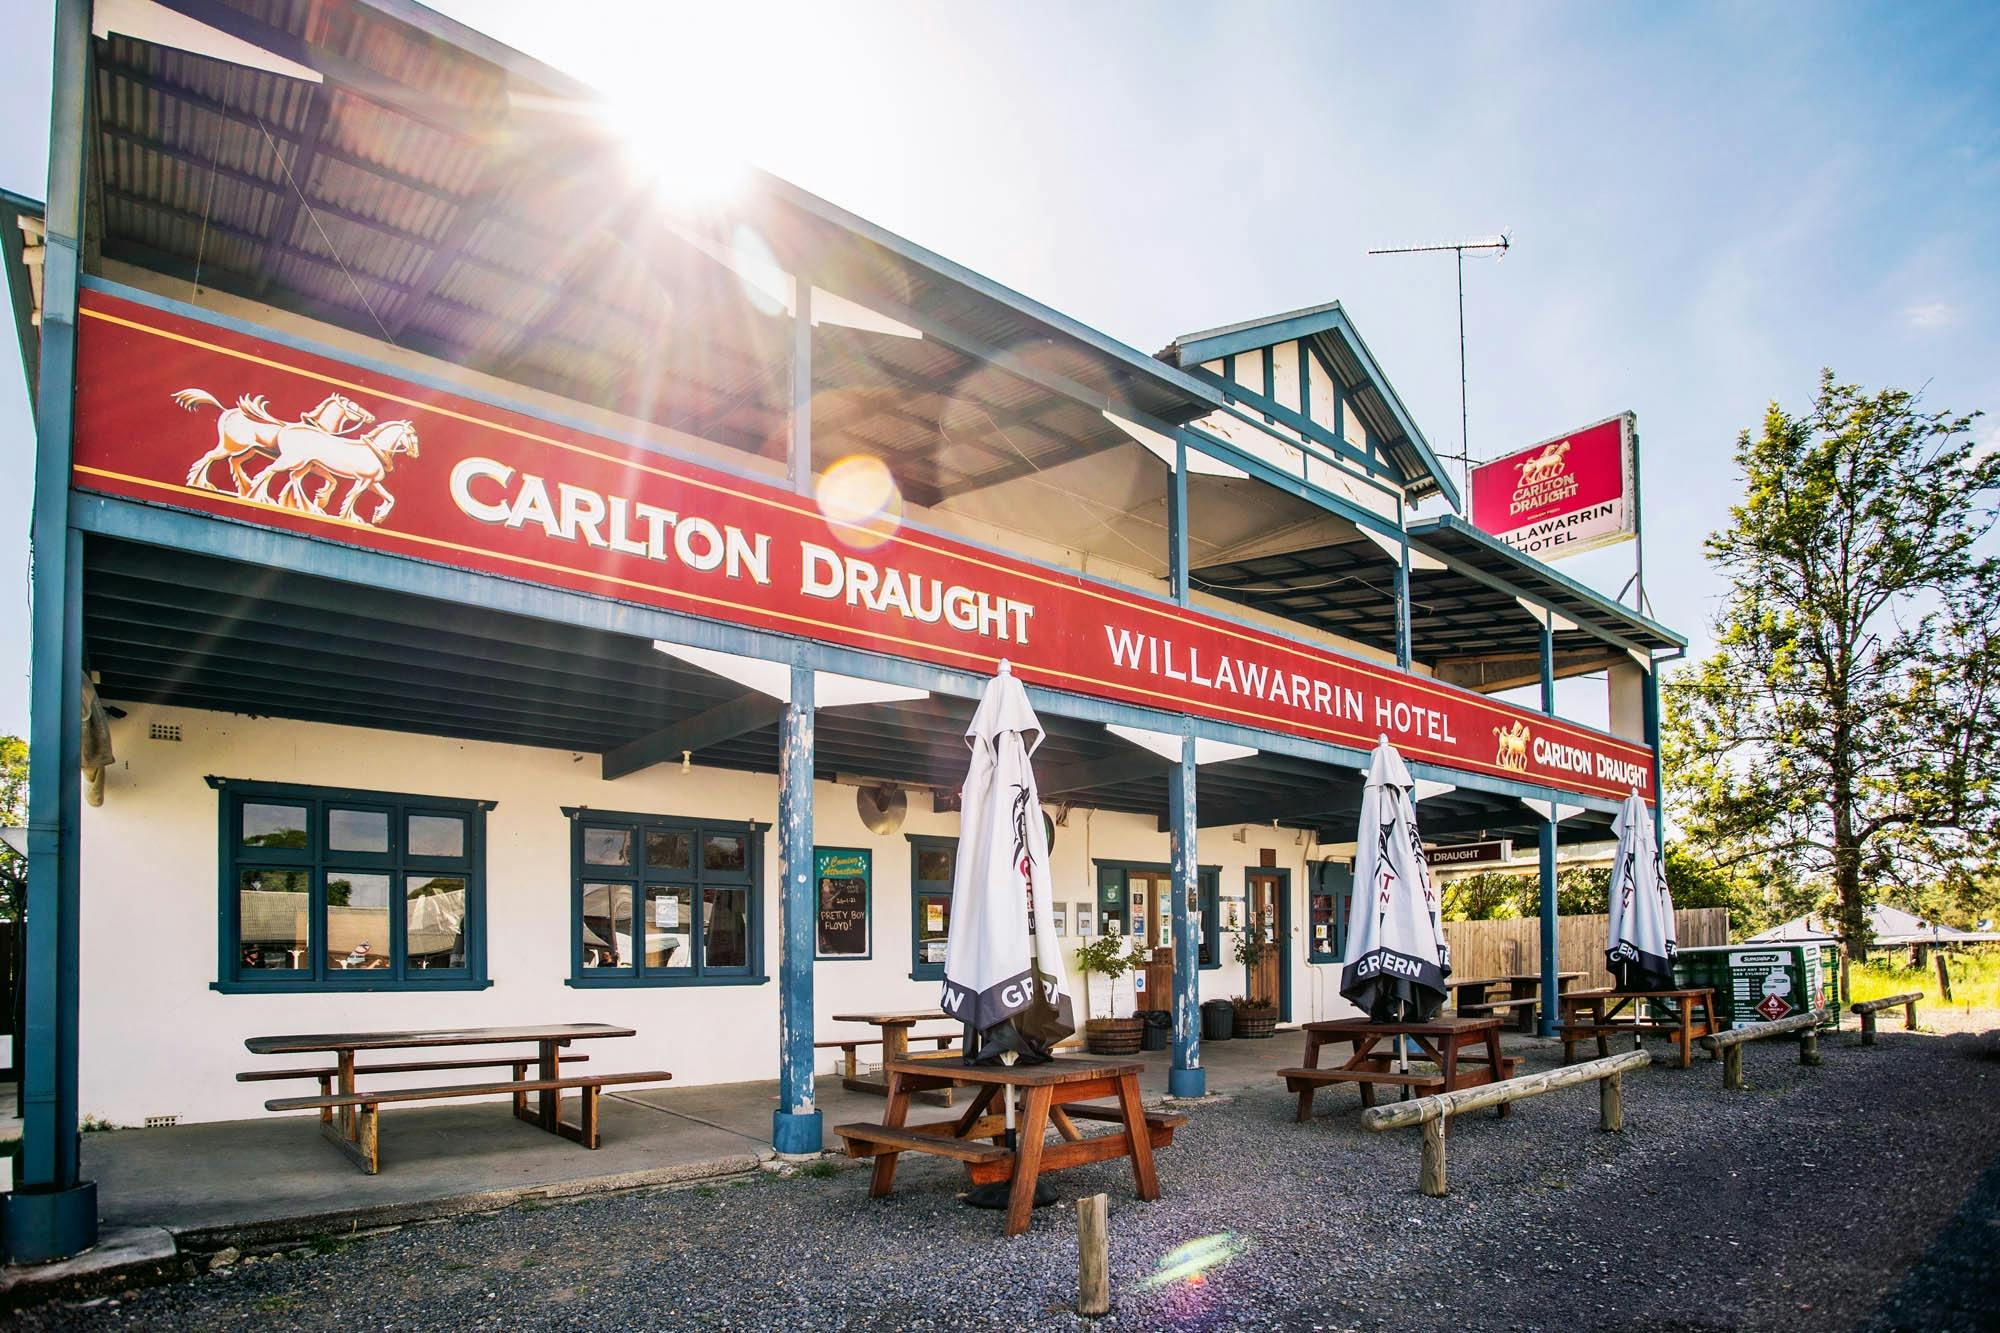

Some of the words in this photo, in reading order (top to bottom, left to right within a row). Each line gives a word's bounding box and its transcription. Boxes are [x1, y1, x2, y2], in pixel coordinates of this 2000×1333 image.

[1510, 483, 1579, 516] DRAUGHT
[1513, 473, 1575, 502] CARLTON
[1499, 504, 1613, 545] ILLAWARRIN
[449, 456, 772, 586] CARLTON
[801, 540, 1035, 646] DRAUGHT
[1517, 531, 1578, 554] HOTEL
[1104, 625, 1365, 723] WILLAWARRIN
[1375, 695, 1457, 745] HOTEL
[1533, 736, 1593, 776] CARLTON
[1596, 752, 1648, 789] DRAUGHT
[1433, 849, 1480, 863] DRAUGHT
[820, 910, 849, 921] PRETTY
[850, 910, 865, 920] BOY
[824, 919, 853, 931] FLOYD!
